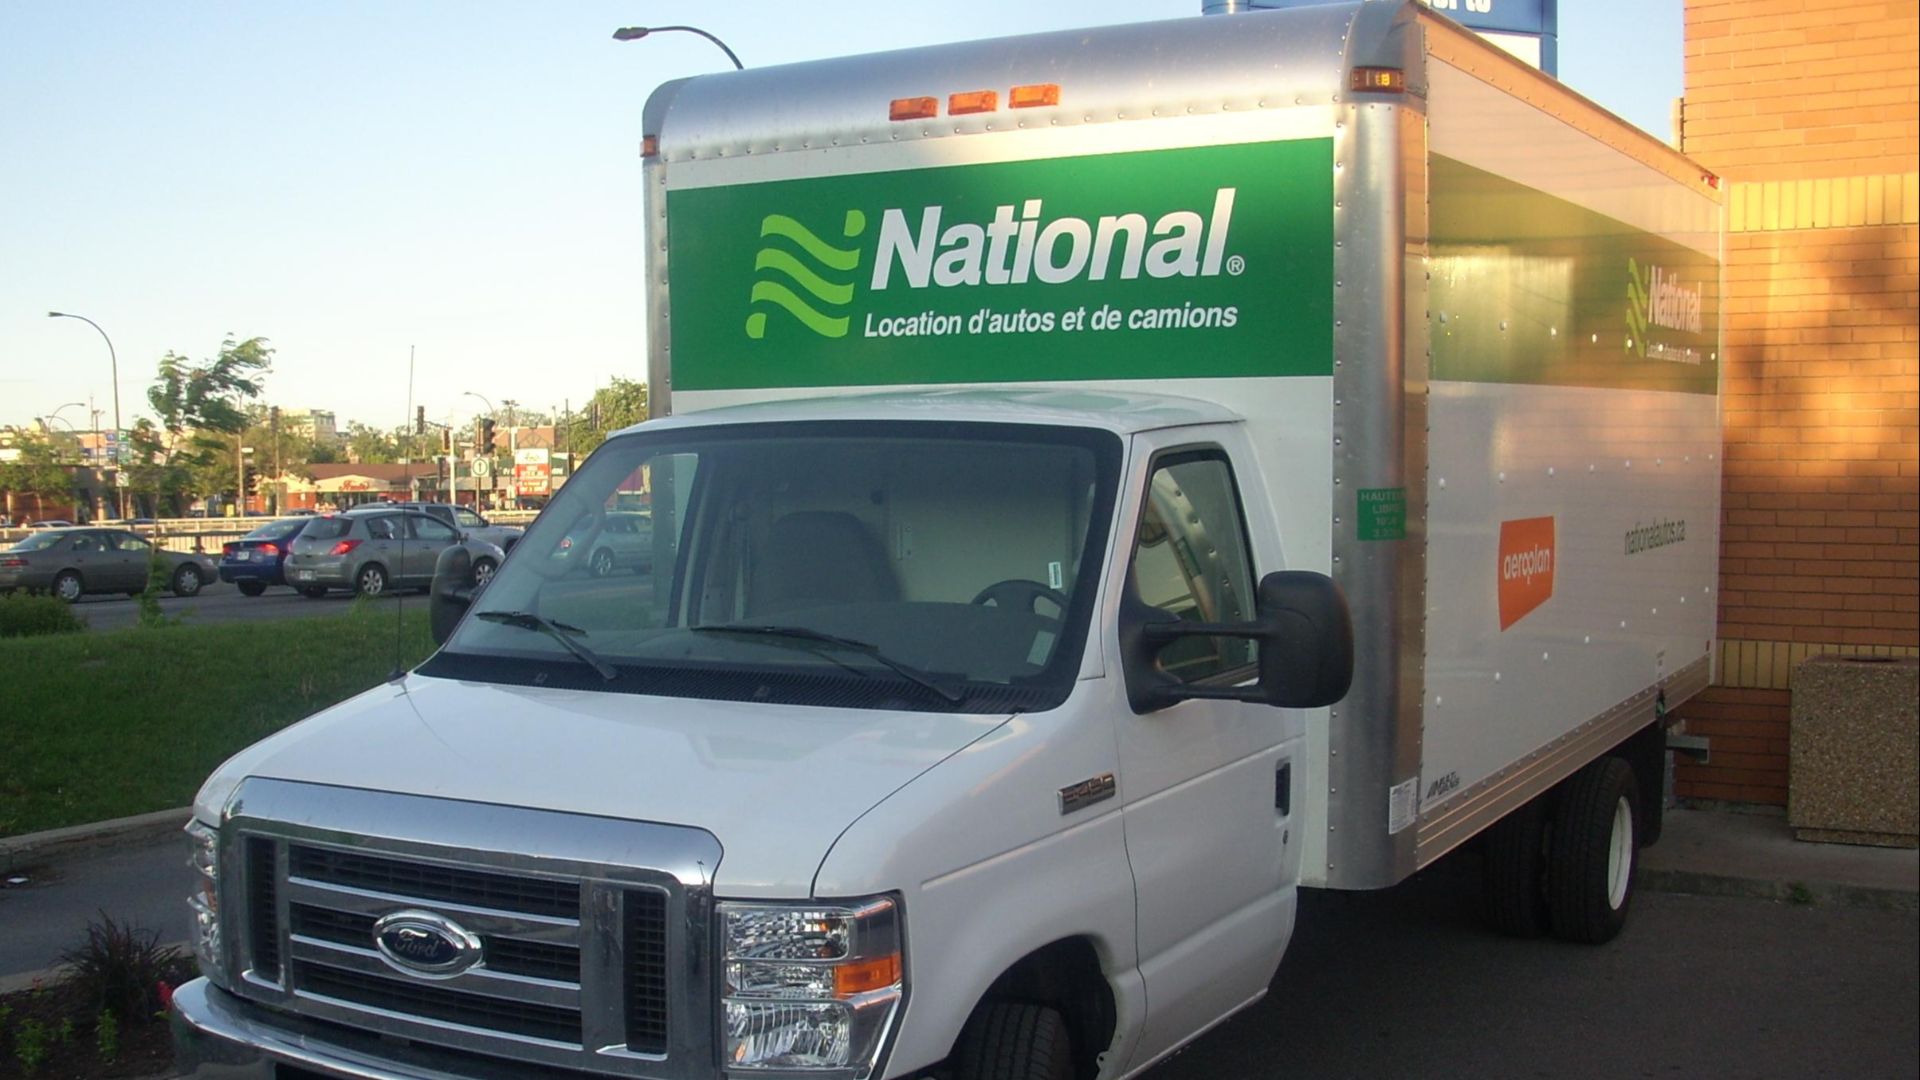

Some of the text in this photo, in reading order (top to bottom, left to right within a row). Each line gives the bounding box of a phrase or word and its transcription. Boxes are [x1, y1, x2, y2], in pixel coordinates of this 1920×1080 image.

[870, 187, 1236, 290] National
[864, 301, 1239, 338] Location d'autos et de camions
[1624, 517, 1685, 556] nationalautos.ca
[1503, 543, 1550, 585] aeroplan
[394, 928, 440, 958] Ford
